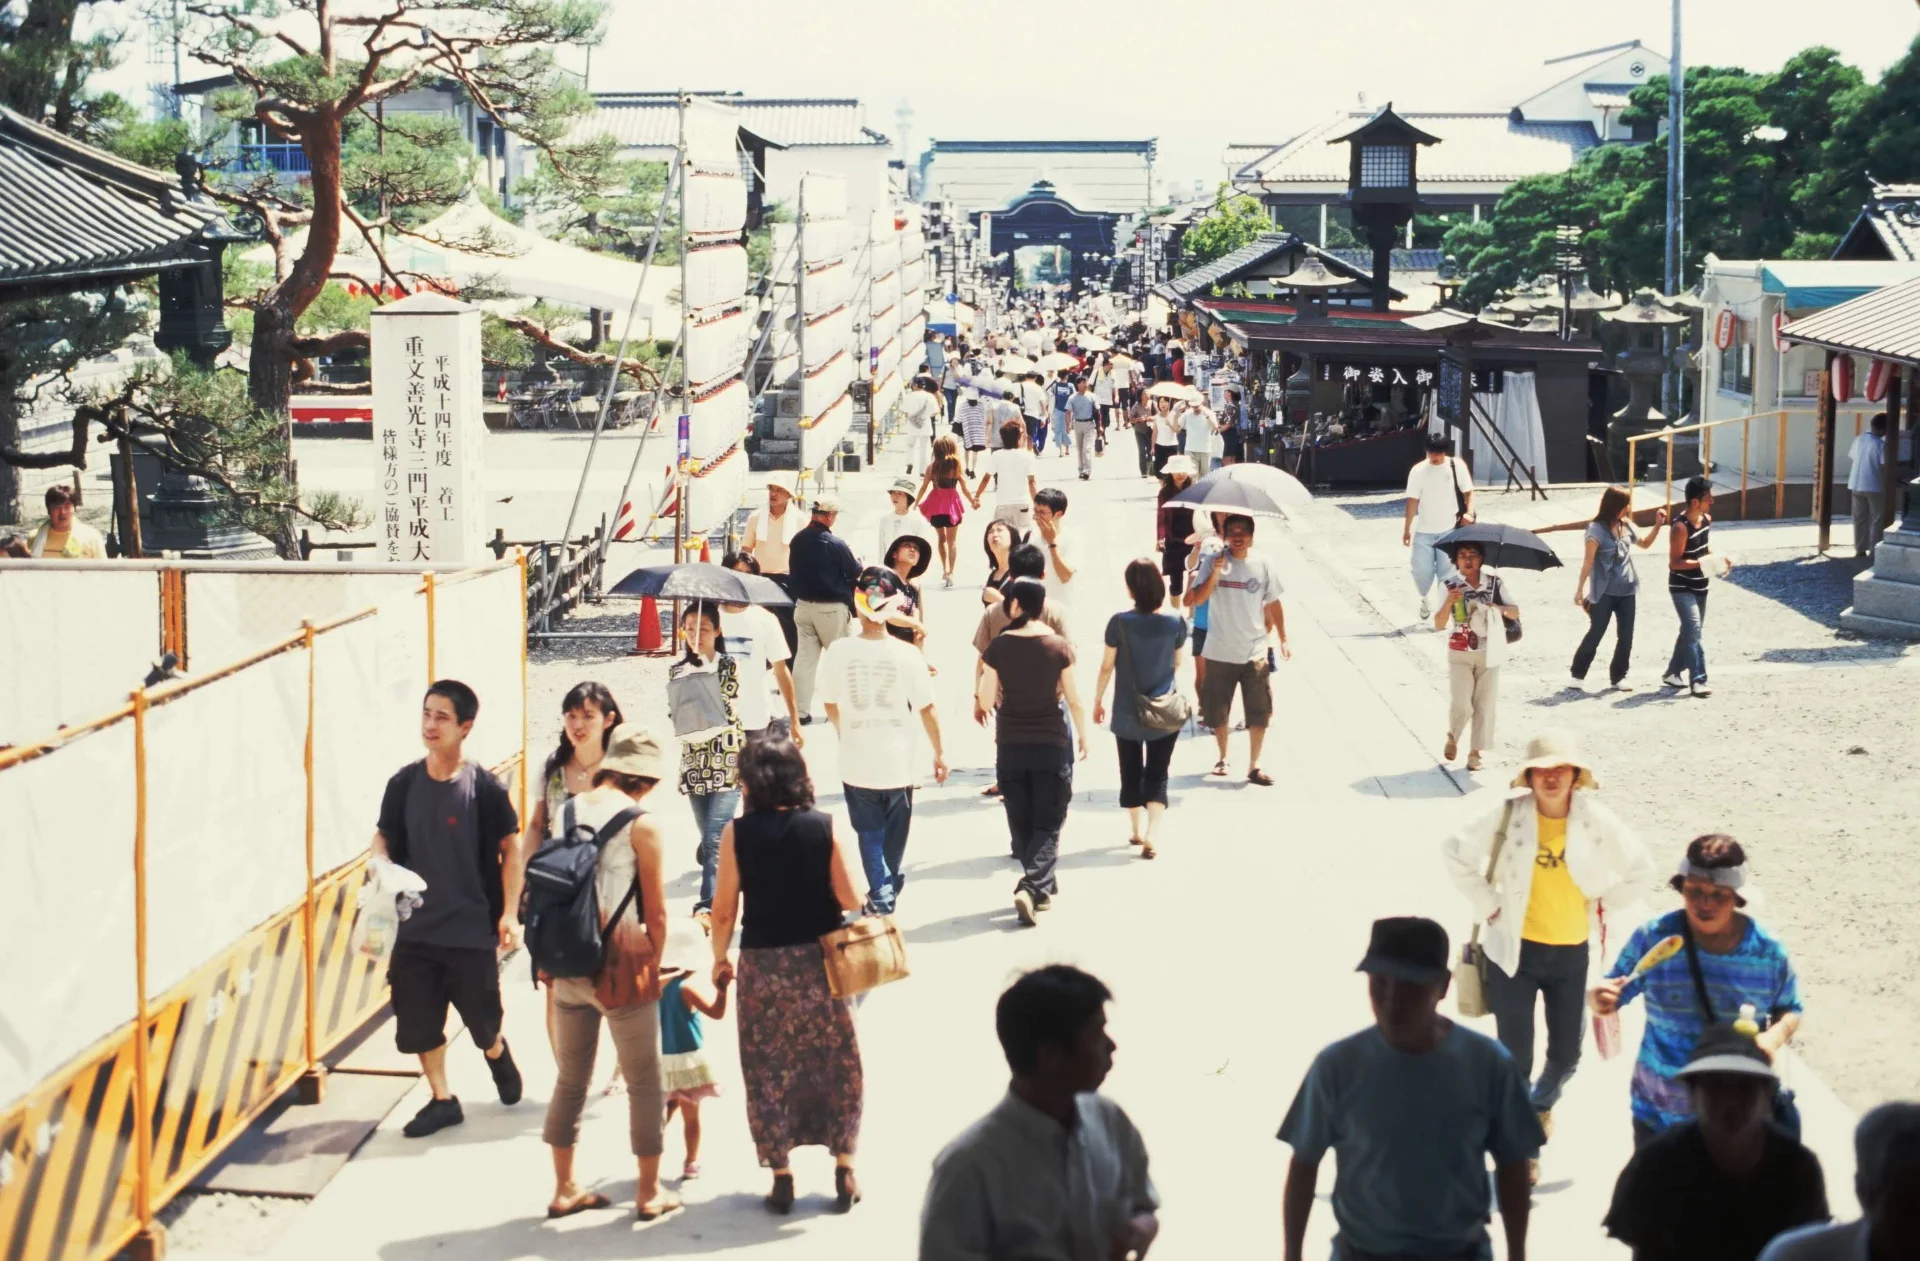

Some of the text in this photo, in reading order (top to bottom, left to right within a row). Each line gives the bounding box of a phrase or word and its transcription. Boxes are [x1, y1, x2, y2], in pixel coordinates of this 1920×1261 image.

[404, 335, 430, 561] 重文善光寺三門平成大
[433, 354, 454, 521] 平成十四年度 着工
